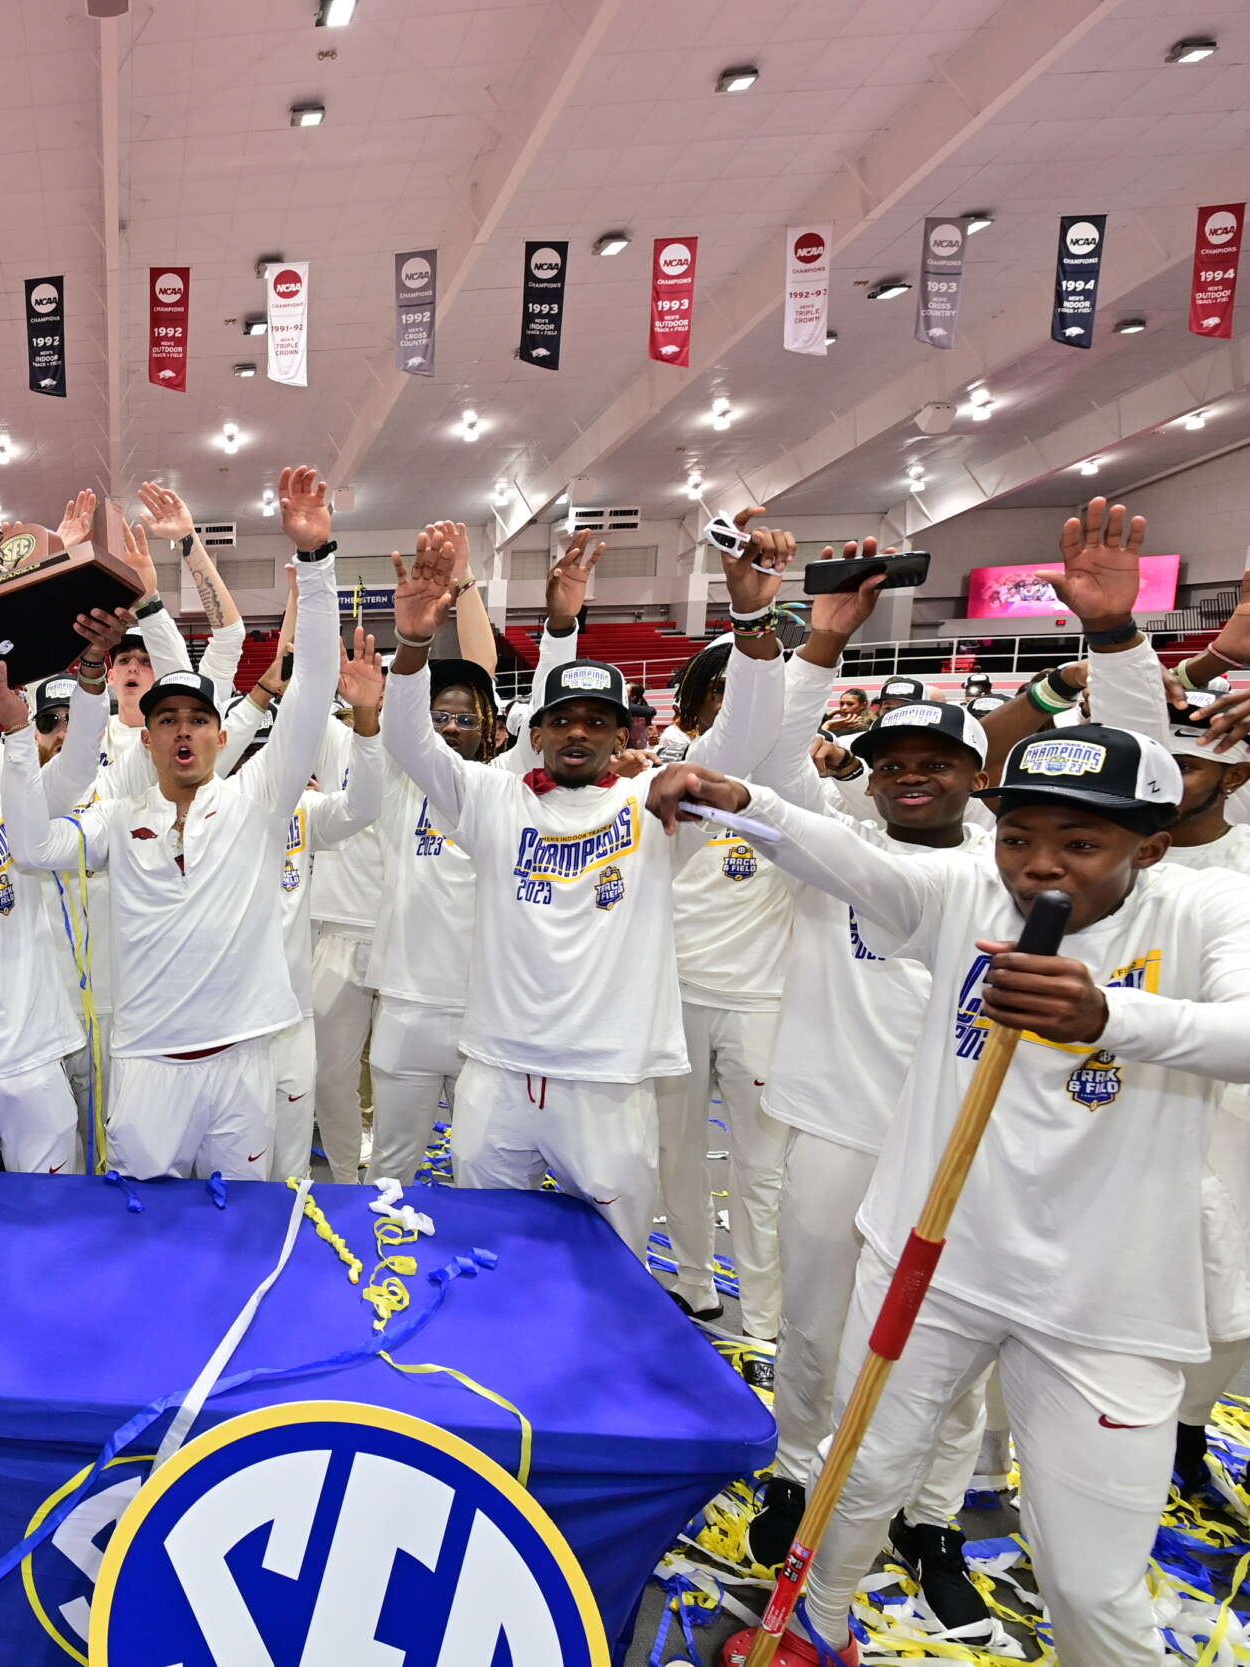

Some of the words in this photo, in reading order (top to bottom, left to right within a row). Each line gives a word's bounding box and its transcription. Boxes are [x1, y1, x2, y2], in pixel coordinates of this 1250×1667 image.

[1208, 225, 1235, 236] NCAA
[932, 239, 960, 248] NCAA
[1069, 238, 1096, 246] NCAA
[796, 246, 824, 257] NCAA
[1201, 246, 1237, 255] CHAMPIONS
[662, 258, 689, 267] NCAA
[927, 258, 961, 266] CHAMPIONS
[1063, 257, 1098, 265] CHAMPIONS
[534, 262, 559, 271] NCAA
[405, 272, 429, 281] NCAA
[1199, 268, 1235, 282] 1994
[657, 277, 691, 285] CHAMPIONS
[1062, 279, 1095, 292] 1994
[158, 287, 182, 296] NCAA
[276, 283, 302, 293] NCAA
[927, 281, 957, 293] 1993
[34, 297, 58, 306] NCAA
[657, 299, 689, 311] 1993
[928, 302, 951, 310] CROSS
[1063, 300, 1090, 308] INDOOR
[528, 303, 559, 314] 1993
[921, 309, 957, 317] COUNTRY
[401, 311, 431, 324] 1992
[795, 315, 820, 324] CROWN
[271, 323, 303, 332] 1991-92
[654, 319, 688, 327] OUTDOOR
[154, 327, 183, 338] 1992
[32, 336, 60, 347] 1992
[3, 539, 28, 560] SEC
[883, 705, 939, 722] CHAMPIONS
[1025, 746, 1102, 767] CHAMPIONS
[560, 833, 586, 842] INDOOR
[724, 858, 756, 866] TRACK
[516, 879, 552, 905] 2023
[1068, 1081, 1081, 1092] &
